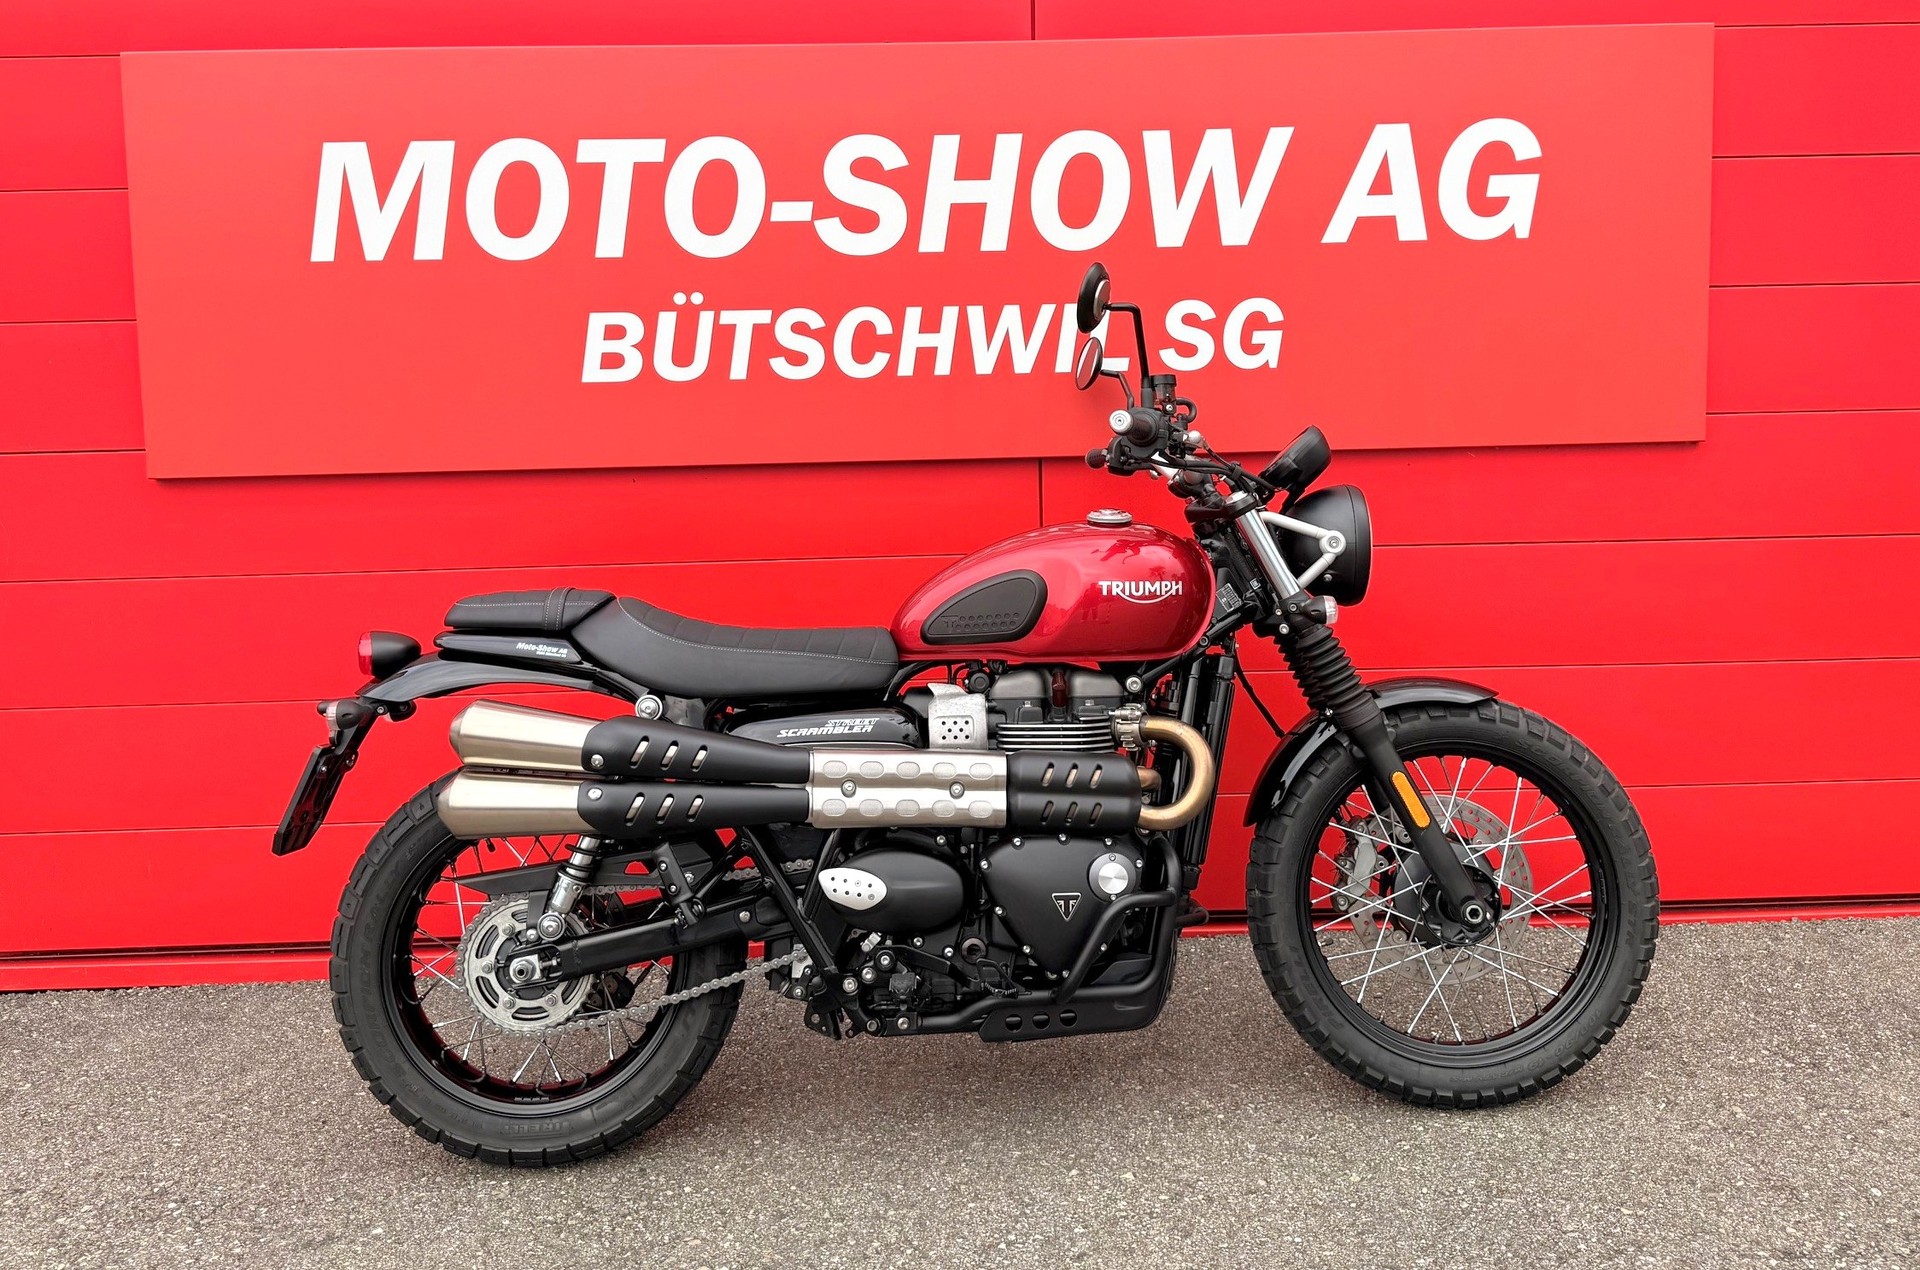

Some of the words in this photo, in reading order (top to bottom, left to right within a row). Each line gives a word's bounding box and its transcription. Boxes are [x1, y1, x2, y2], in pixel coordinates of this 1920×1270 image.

[311, 127, 1294, 261] MOTO-SHOW
[1321, 118, 1542, 244] AG
[1158, 298, 1284, 372] SG
[1098, 580, 1183, 604] TRIUMPH
[515, 642, 559, 653] Moto-Show
[777, 725, 873, 738] SCRAMBLER
[825, 718, 880, 727] STREET
